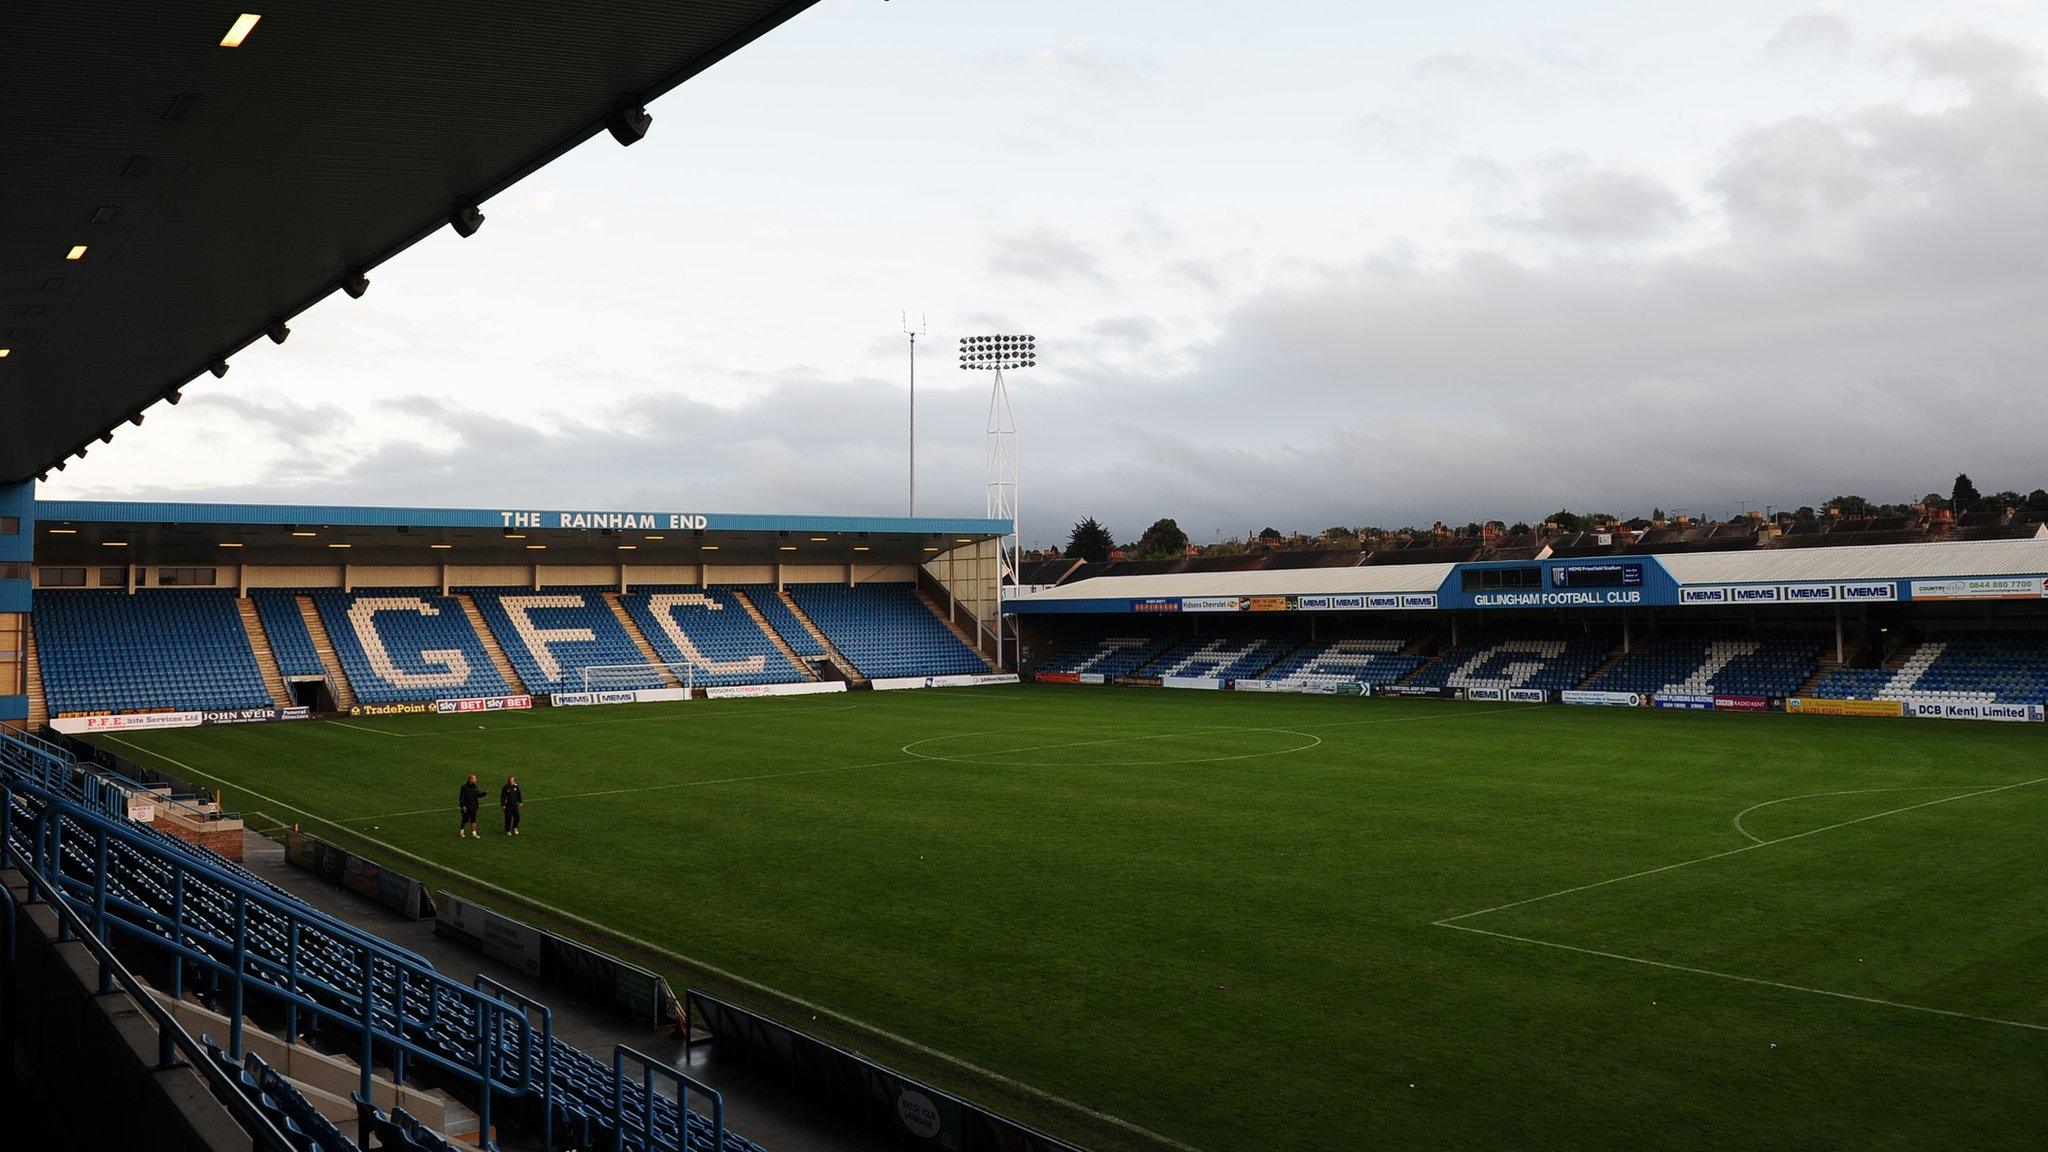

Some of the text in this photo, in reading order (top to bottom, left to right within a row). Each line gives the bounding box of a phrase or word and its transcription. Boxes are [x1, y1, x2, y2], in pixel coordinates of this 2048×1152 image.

[500, 512, 708, 529] THE RAINHAM END
[1686, 591, 1722, 600] MEMS
[1737, 589, 1774, 599] MEMS
[1790, 588, 1829, 598] MEMS
[1846, 587, 1888, 597] MEMS
[1303, 599, 1327, 607] MEMS
[1335, 598, 1360, 607] MEMS
[1370, 597, 1395, 606] MEMS
[1405, 596, 1432, 606] MEMS
[1474, 591, 1641, 606] GILLINGHAM FOOTBALL CLUB
[1470, 691, 1499, 699] MEMS
[1510, 692, 1540, 700] MEMS
[439, 700, 483, 712] sky BET
[486, 697, 528, 709] sky BET
[363, 703, 425, 715] TradePoint
[1919, 705, 2025, 718] DCB (Kent) Limited
[203, 710, 276, 720] JOHN WEIR
[87, 717, 126, 728] P.F.E.
[127, 717, 144, 725] Site
[146, 716, 182, 724] Services
